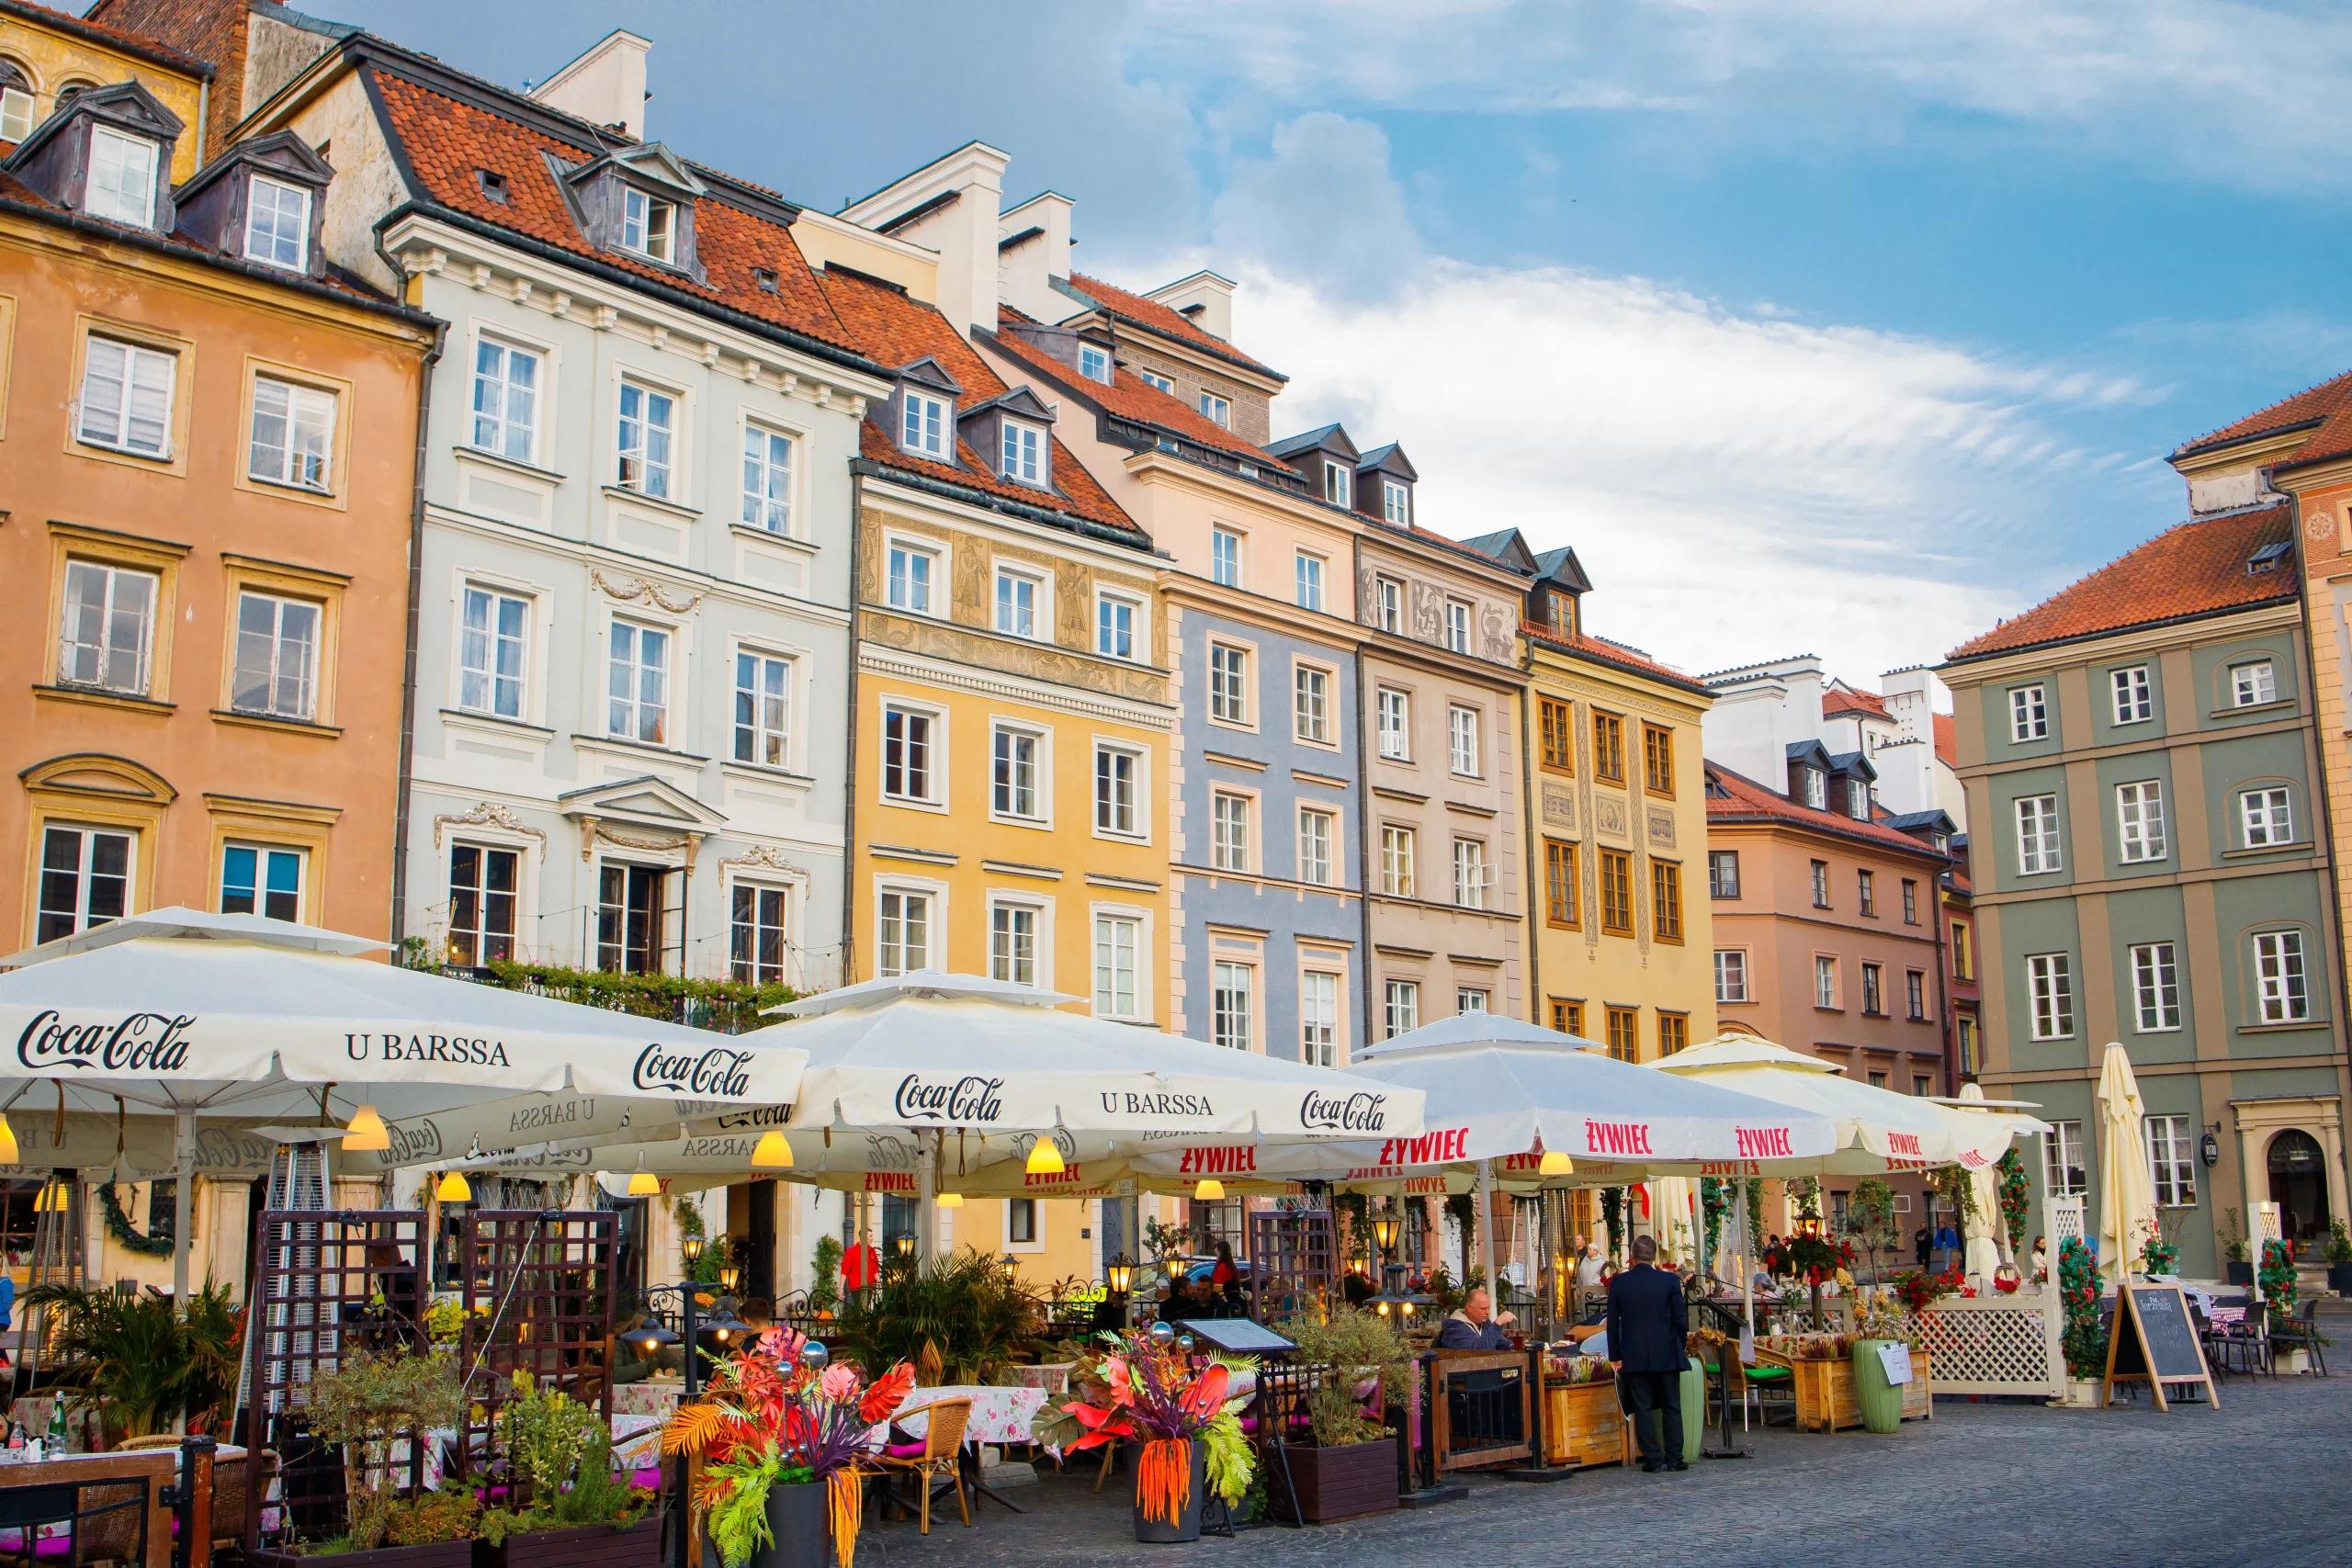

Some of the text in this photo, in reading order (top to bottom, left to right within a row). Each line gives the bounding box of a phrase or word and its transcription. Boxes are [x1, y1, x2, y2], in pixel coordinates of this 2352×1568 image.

[17, 1010, 198, 1070] Coca-Cola
[345, 1034, 511, 1066] U BARSSA
[633, 1043, 756, 1097] Coca-Cola
[896, 1074, 1005, 1122] Coca-Cola
[1100, 1093, 1214, 1116] U BARSSA
[1301, 1090, 1387, 1131] Coca-Cola
[1586, 1118, 1653, 1155] ŻYWIEC
[1736, 1125, 1793, 1156] ŻYWIEC
[1888, 1131, 1922, 1156] ŻYWIEC
